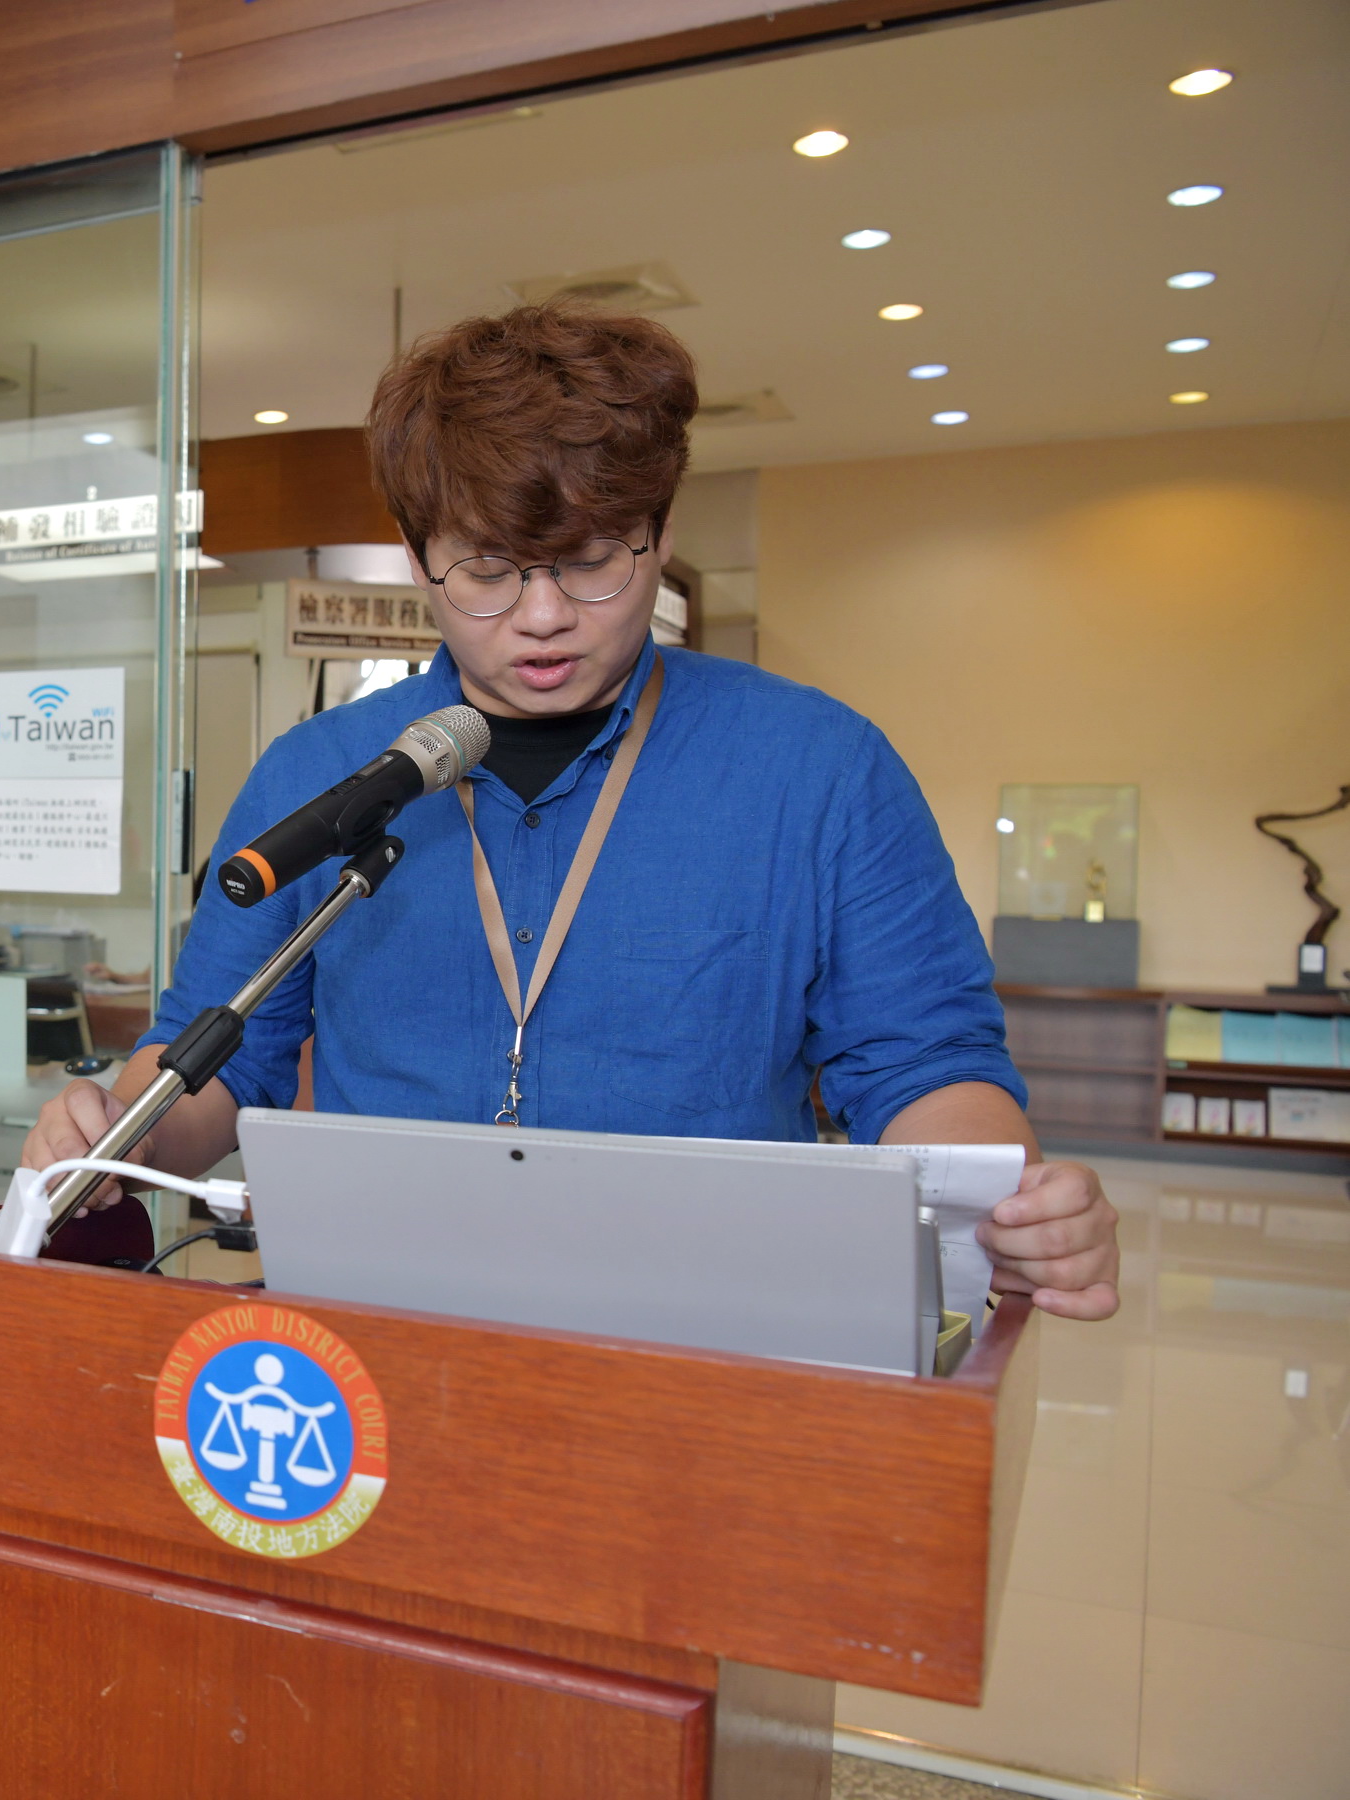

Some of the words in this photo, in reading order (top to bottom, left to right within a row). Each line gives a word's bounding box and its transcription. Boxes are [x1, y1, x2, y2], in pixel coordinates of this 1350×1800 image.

[226, 879, 246, 889] MIPRO
[157, 1346, 195, 1421] TAIWAN
[189, 1307, 260, 1351] NANTOU
[271, 1308, 366, 1385] DISTRICT
[354, 1393, 387, 1465] COURT
[168, 1460, 372, 1558] 臺灣南投地方法院
